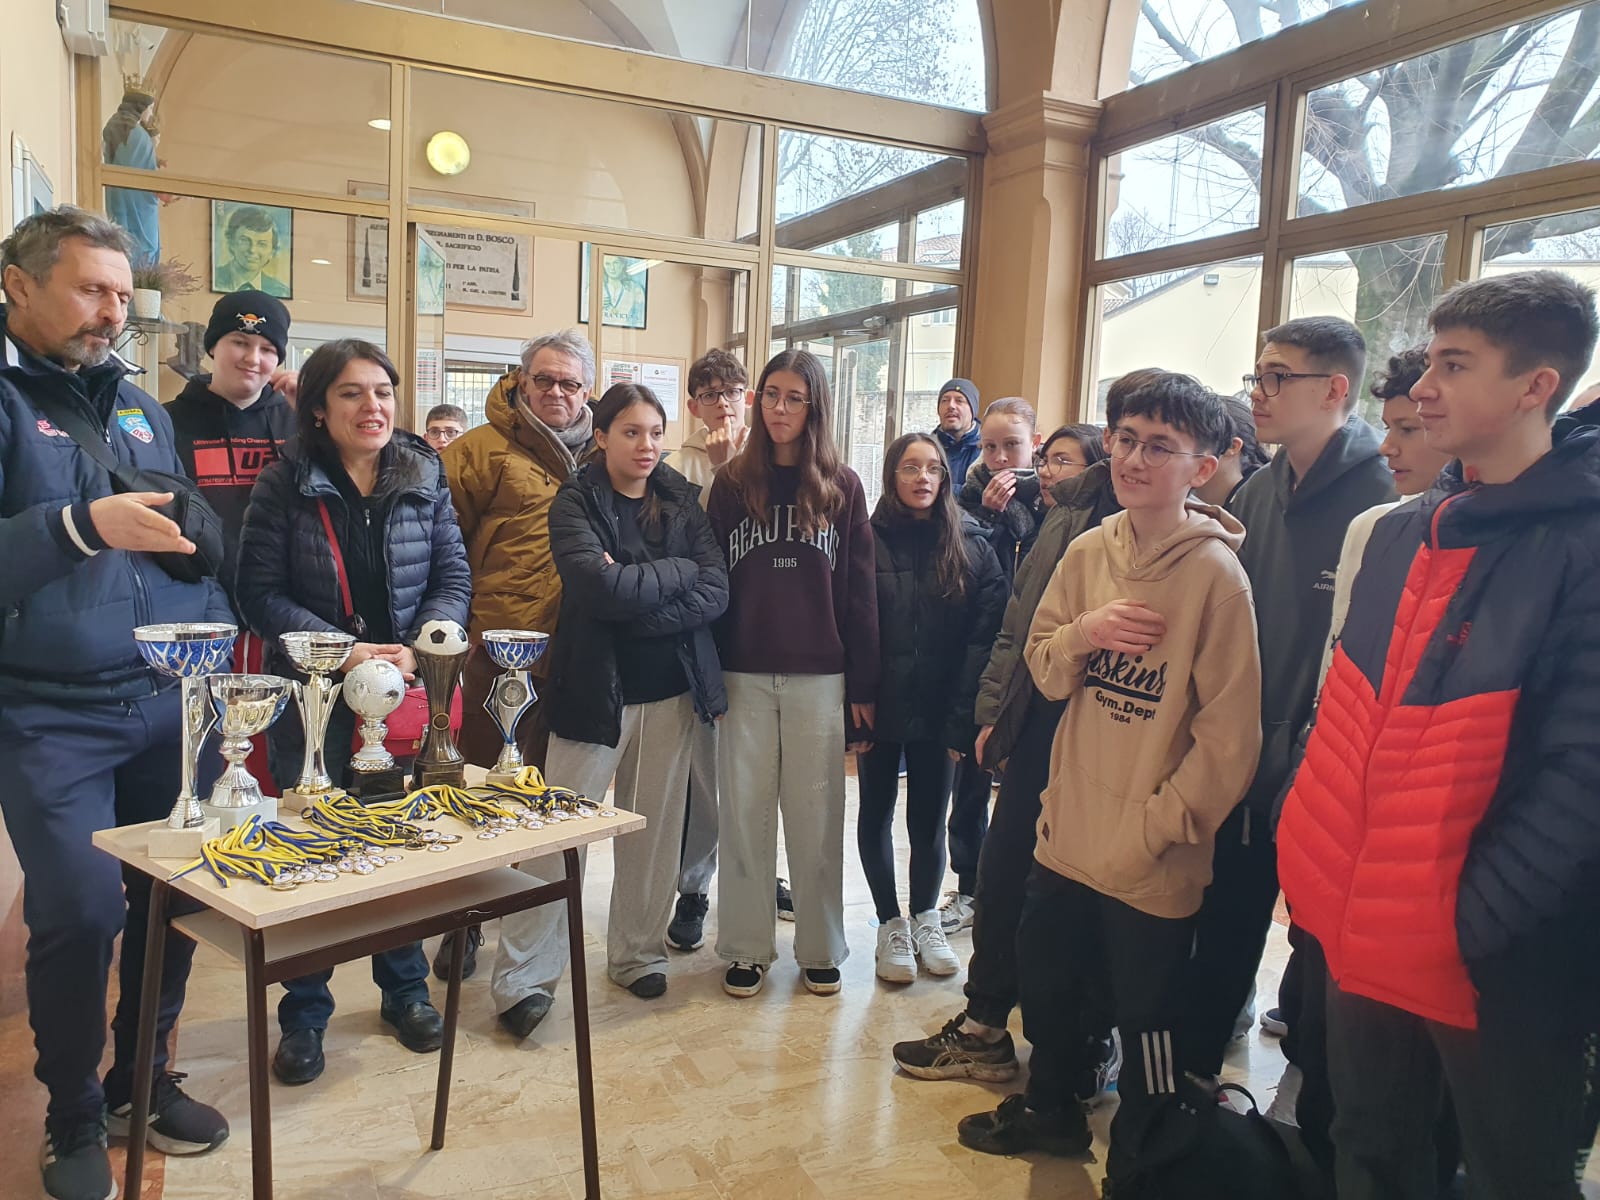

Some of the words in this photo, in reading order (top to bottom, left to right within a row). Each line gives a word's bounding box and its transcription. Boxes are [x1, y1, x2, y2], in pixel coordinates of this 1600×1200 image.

[486, 234, 515, 244] BOSCO
[242, 451, 273, 469] UF
[729, 504, 781, 573] BEAU
[772, 557, 797, 568] 1995
[1312, 582, 1335, 591] AIRN
[1110, 711, 1131, 724] 1984
